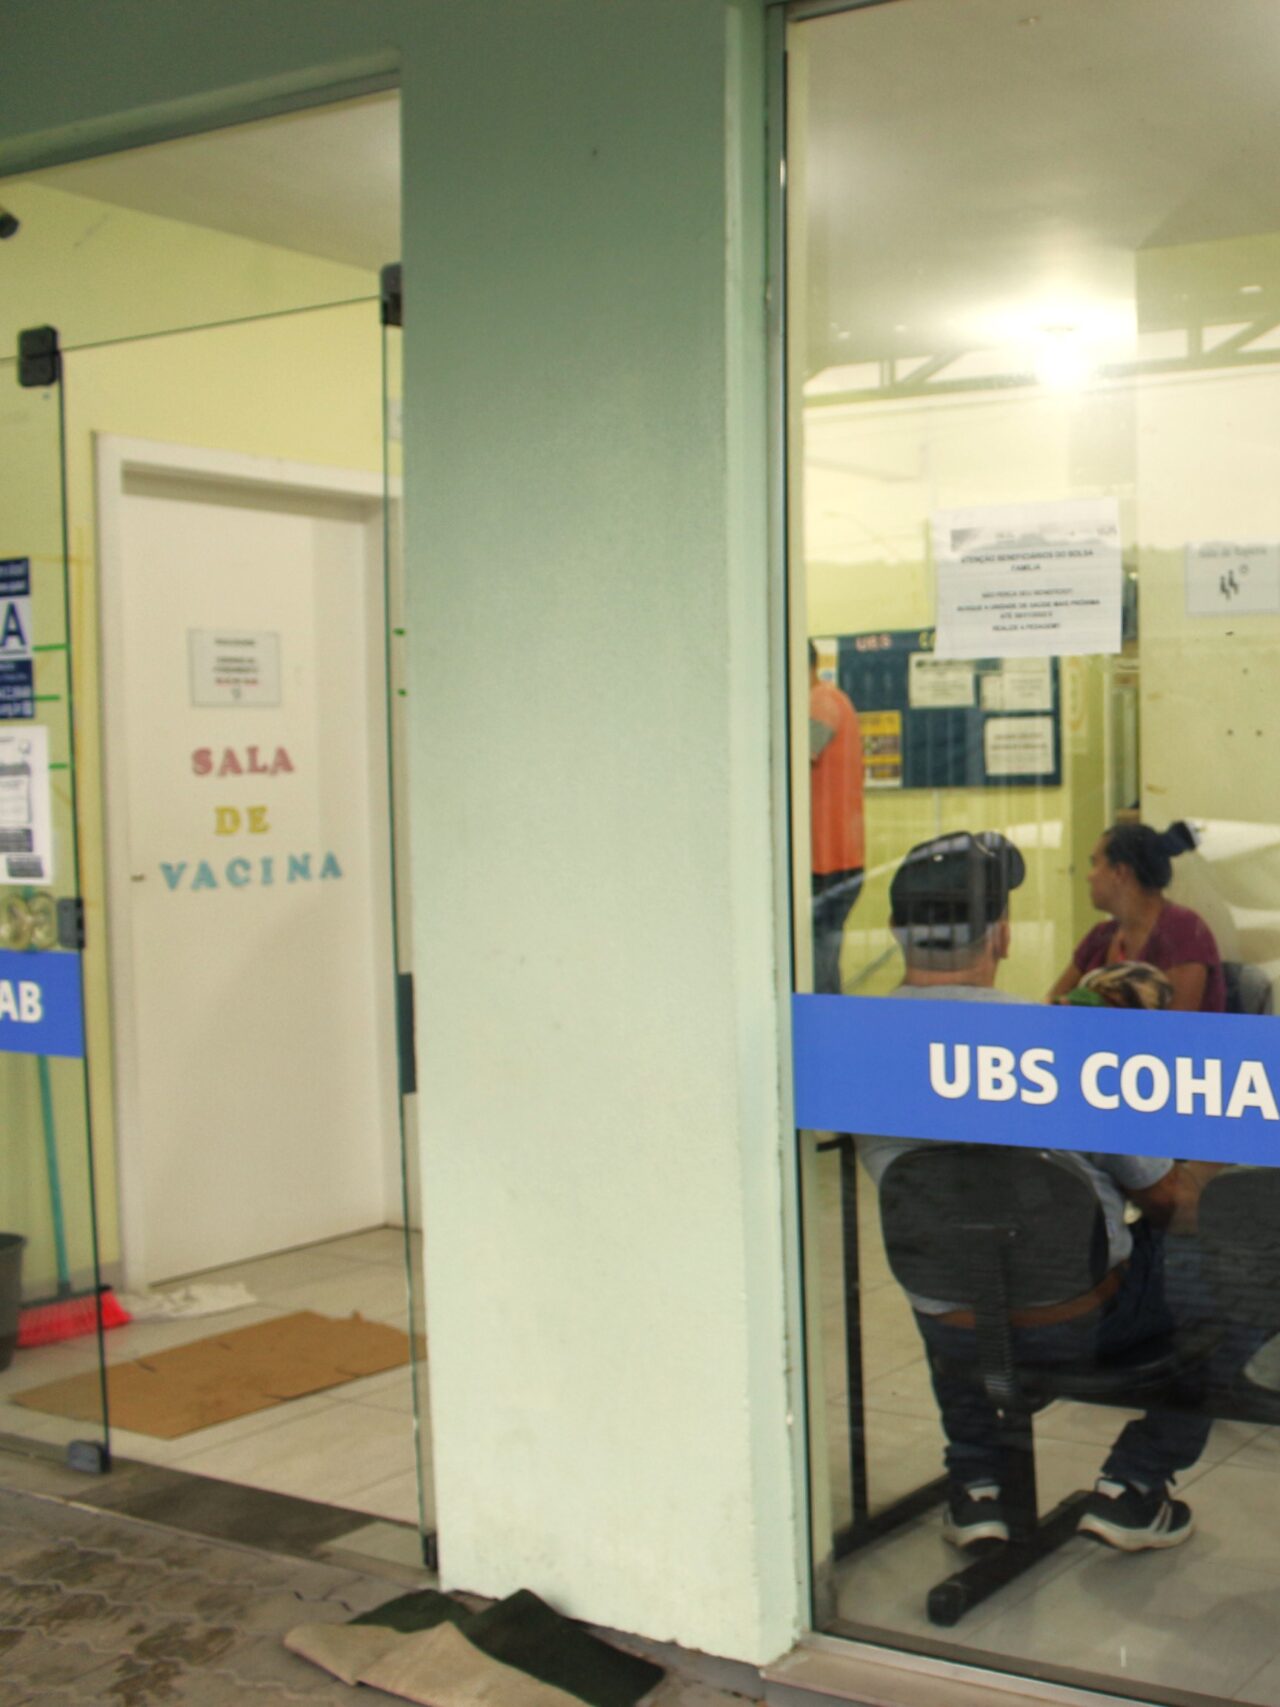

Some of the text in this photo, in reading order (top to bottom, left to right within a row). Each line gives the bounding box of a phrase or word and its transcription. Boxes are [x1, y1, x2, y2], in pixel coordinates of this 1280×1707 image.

[1067, 549, 1094, 559] BOLSA
[191, 746, 295, 776] SALA
[214, 806, 271, 835] DE
[159, 852, 343, 890] VACINA
[929, 1042, 1059, 1105] UBS
